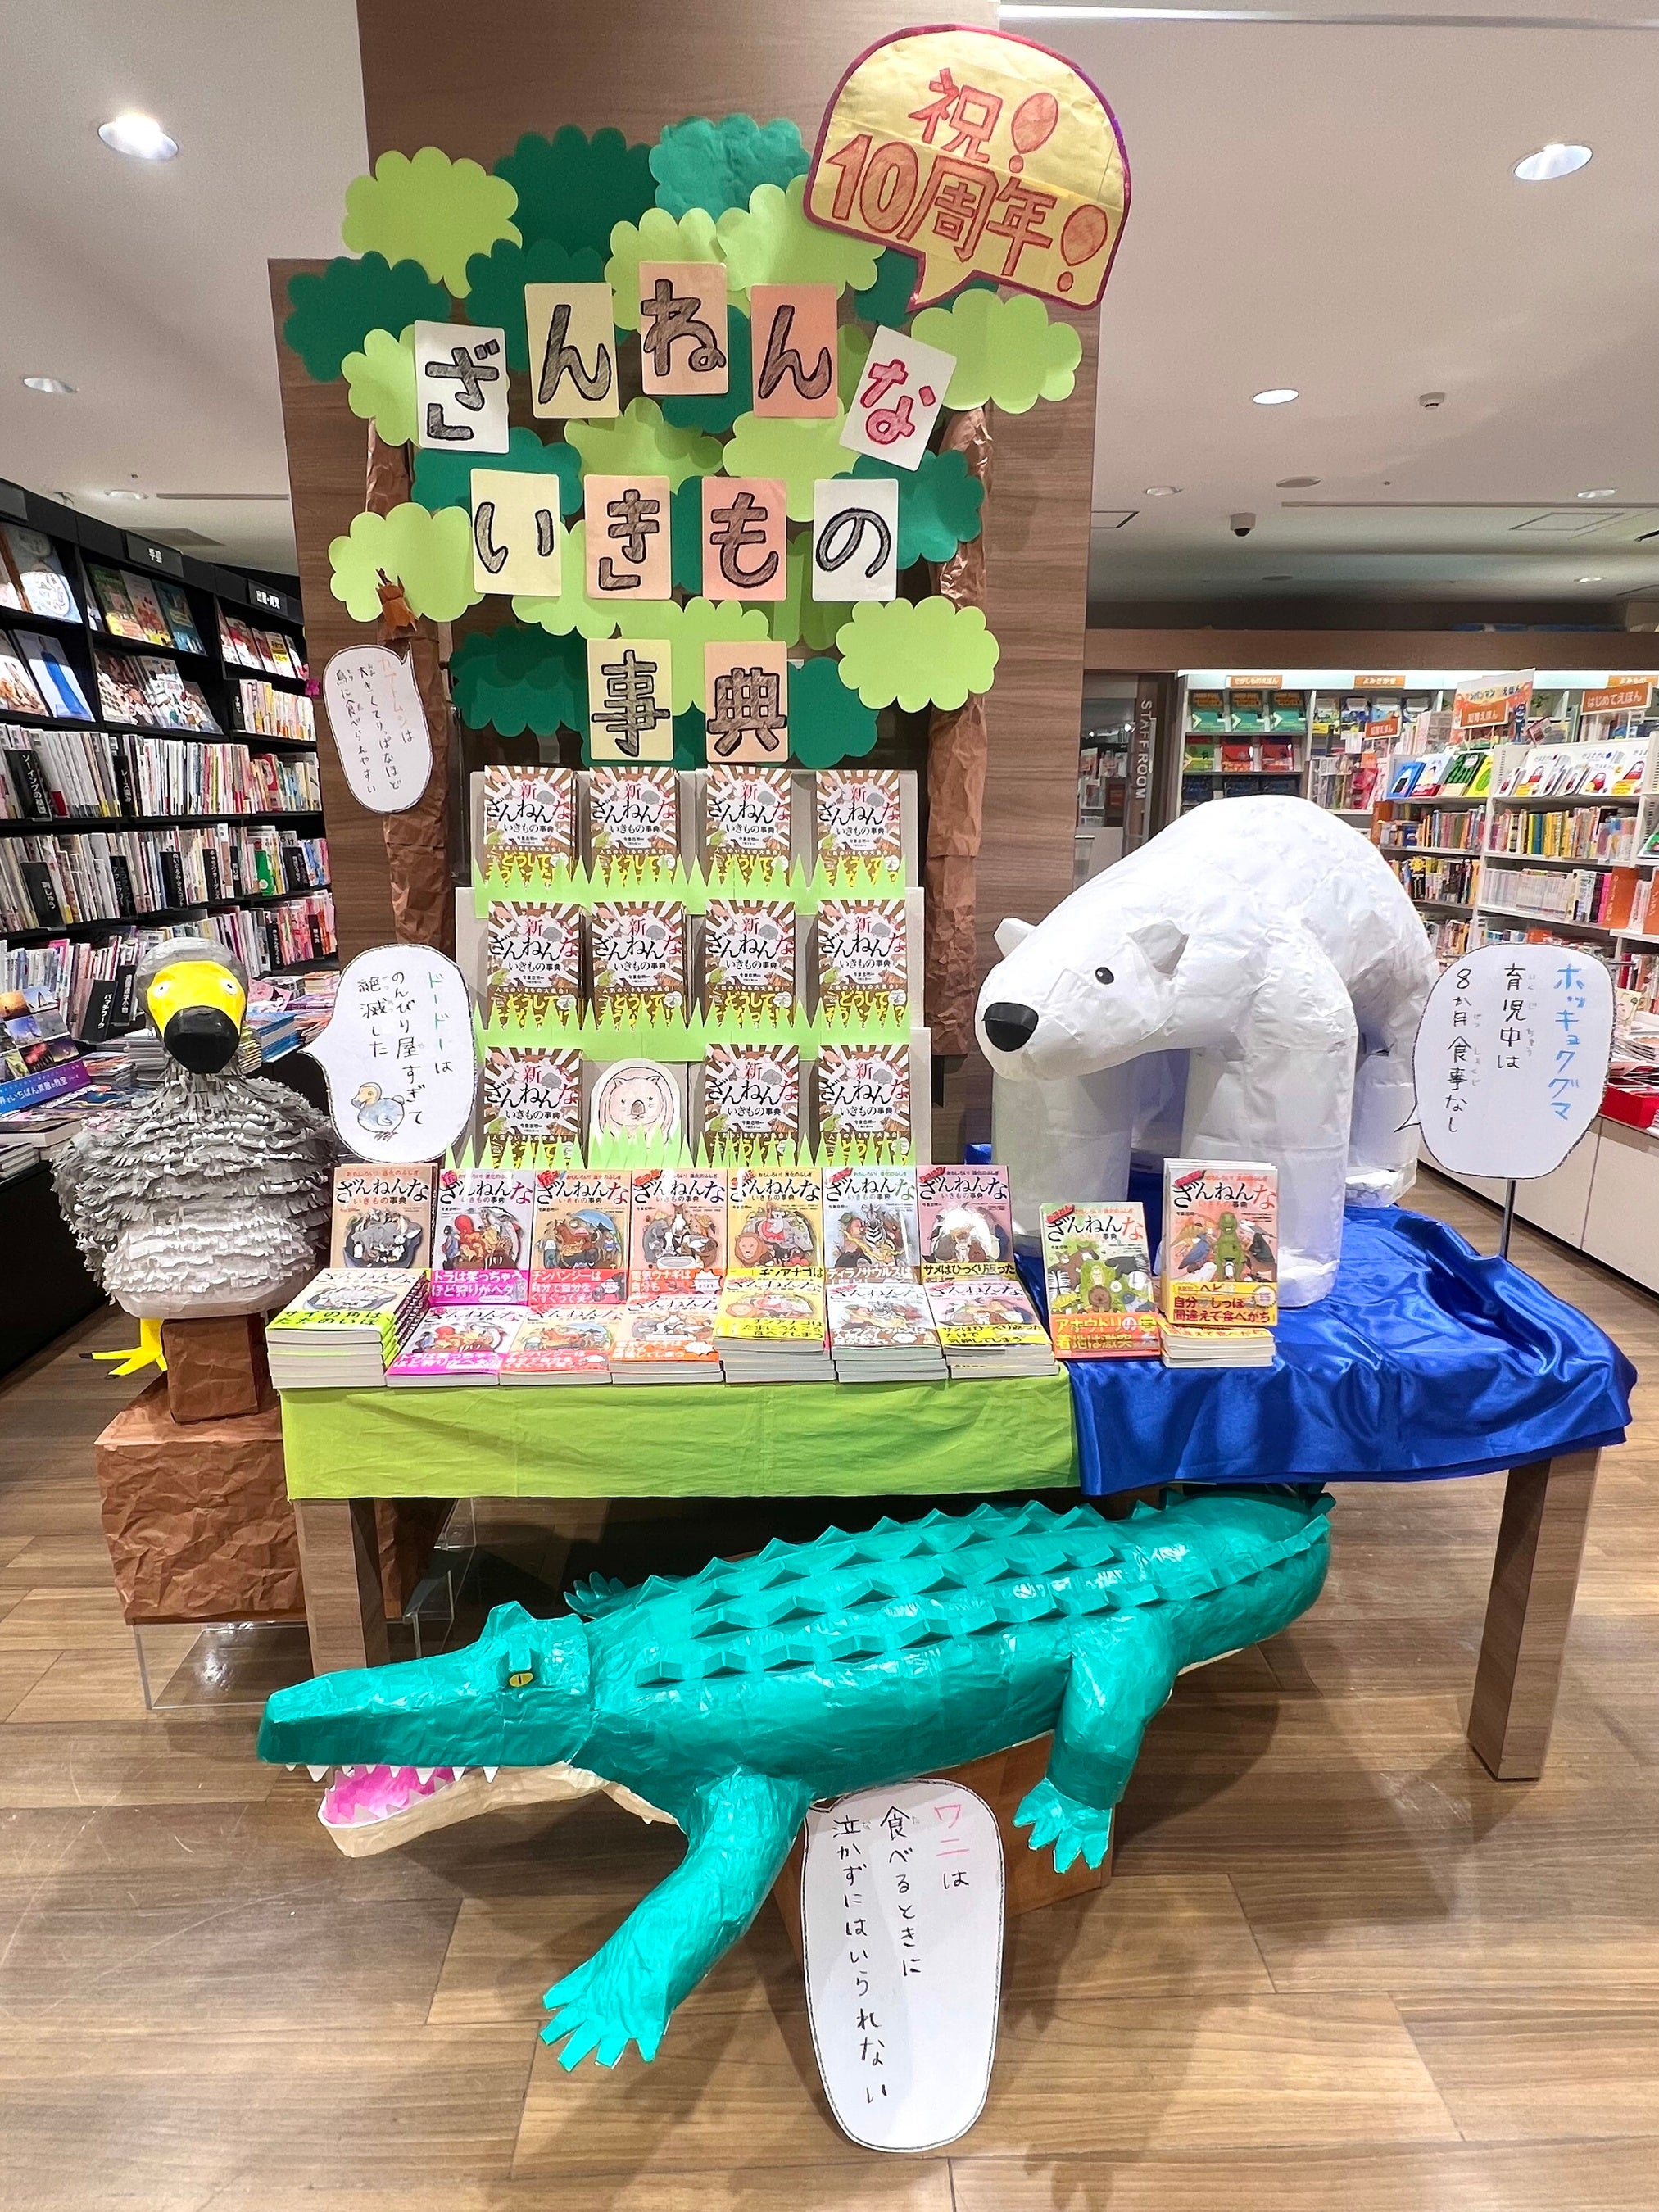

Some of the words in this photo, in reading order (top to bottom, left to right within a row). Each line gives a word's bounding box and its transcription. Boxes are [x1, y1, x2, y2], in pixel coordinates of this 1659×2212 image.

[424, 279, 936, 445] ざんねんな
[473, 488, 891, 591] いきもの
[591, 649, 787, 756] 事典
[1140, 700, 1153, 749] STAFF
[1135, 751, 1149, 800] ROOM
[520, 782, 537, 800] 新
[625, 782, 642, 800] 新
[741, 784, 758, 800] 新
[851, 786, 867, 800] 新
[486, 797, 572, 823] ざんねんな
[592, 799, 676, 823] ざんねんな
[708, 797, 790, 824] ざんねんな
[818, 802, 900, 826] ざんねんな
[504, 823, 555, 834] いきもの事典
[610, 823, 660, 834] いきもの事典
[725, 824, 775, 834] いきもの事典
[836, 827, 885, 836] いきもの事典
[525, 918, 542, 937] 新
[628, 918, 646, 936] 新
[741, 916, 760, 935] 新
[854, 916, 872, 934] 新
[489, 935, 578, 961] ざんねんな
[594, 936, 682, 961] ざんねんな
[707, 932, 795, 959] ざんねんな
[821, 932, 906, 959] ざんねんな
[509, 961, 561, 972] いきもの事典
[614, 961, 666, 971] いきもの事典
[726, 959, 777, 970] いきもの事典
[840, 959, 891, 969] いきもの事典
[98, 993, 112, 1030] パッチワーク
[358, 976, 388, 1058] 絶滅した
[428, 971, 453, 1074] ドードーは
[1497, 963, 1526, 1070] 育児中は
[392, 972, 425, 1125] のんびり屋すぎて
[1548, 963, 1586, 1121] ホッキョクグマ
[523, 1065, 542, 1084] 新
[743, 1062, 763, 1080] 新
[855, 1062, 873, 1080] 新
[486, 1081, 578, 1109] ざんねんな
[708, 1078, 800, 1106] ざんねんな
[820, 1079, 909, 1105] ざんねんな
[505, 1110, 560, 1120] いきもの事典
[727, 1107, 782, 1117] いきもの事典
[839, 1107, 893, 1117] いきもの事典
[336, 1177, 429, 1203] ざんねんな
[537, 1180, 629, 1205] ざんねんな
[826, 1178, 915, 1203] ざんねんな
[919, 1176, 1008, 1201] ざんねんな
[1172, 1181, 1277, 1210] ざんねんな
[353, 1197, 407, 1205] いきもの事典
[1045, 1215, 1144, 1243] ざんねんな
[434, 1271, 524, 1283] トラは笑っちゃう
[533, 1271, 602, 1281] チンパンジーは
[827, 1267, 912, 1279] ティラノサウルスは
[431, 1283, 514, 1297] ほど狩りがヘタ
[532, 1282, 592, 1293] 自分で自分を
[1054, 1317, 1138, 1333] アホウドリの
[1173, 1309, 1271, 1323] 間違えて食べがち
[934, 1804, 971, 1888] ワニは
[879, 1806, 922, 1977] 食べるときに
[832, 1815, 887, 2104] 泣かずにはいられない
